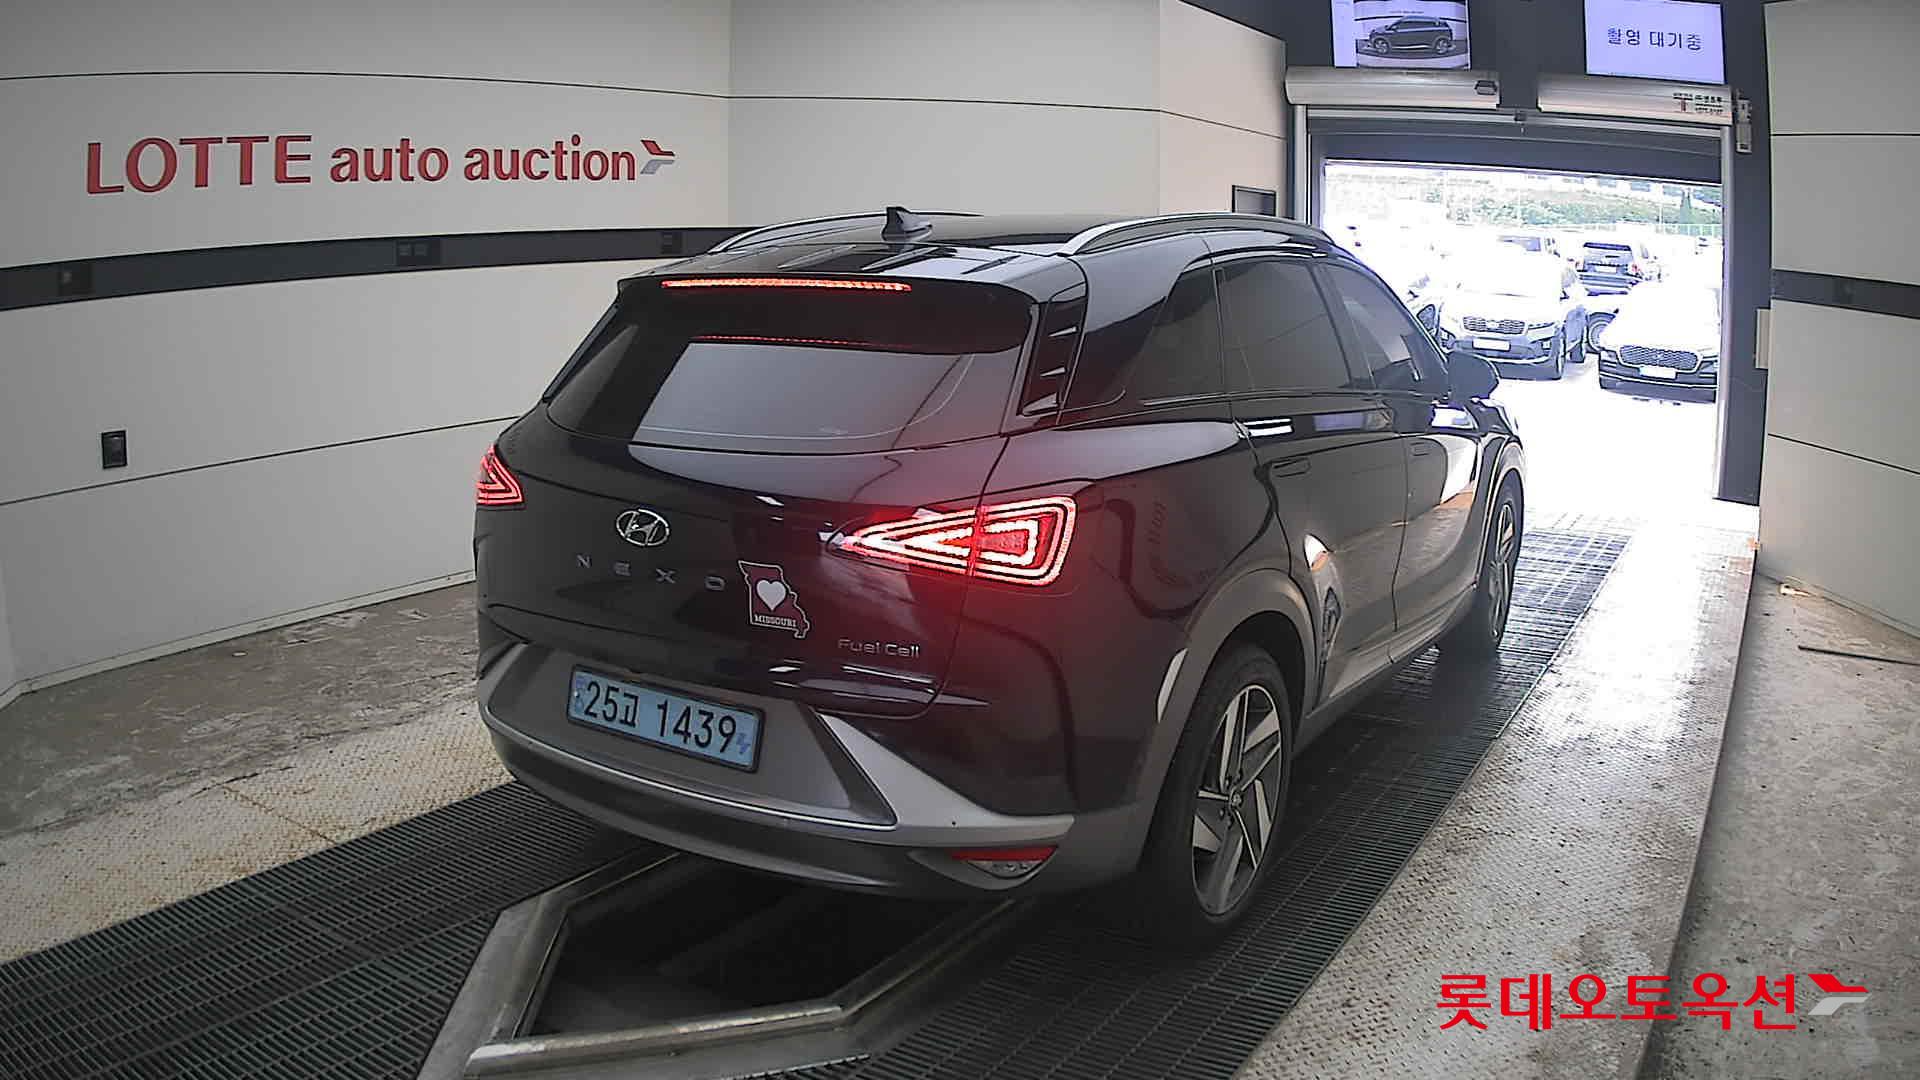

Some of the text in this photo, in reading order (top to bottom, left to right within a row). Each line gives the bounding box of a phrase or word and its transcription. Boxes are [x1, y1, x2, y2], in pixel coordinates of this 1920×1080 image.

[86, 134, 637, 194] LOTTE auto auction
[576, 554, 726, 591] NEXO
[754, 614, 797, 627] MISSOURI
[838, 639, 920, 658] Fuel Cell
[583, 680, 738, 753] 25고 1439
